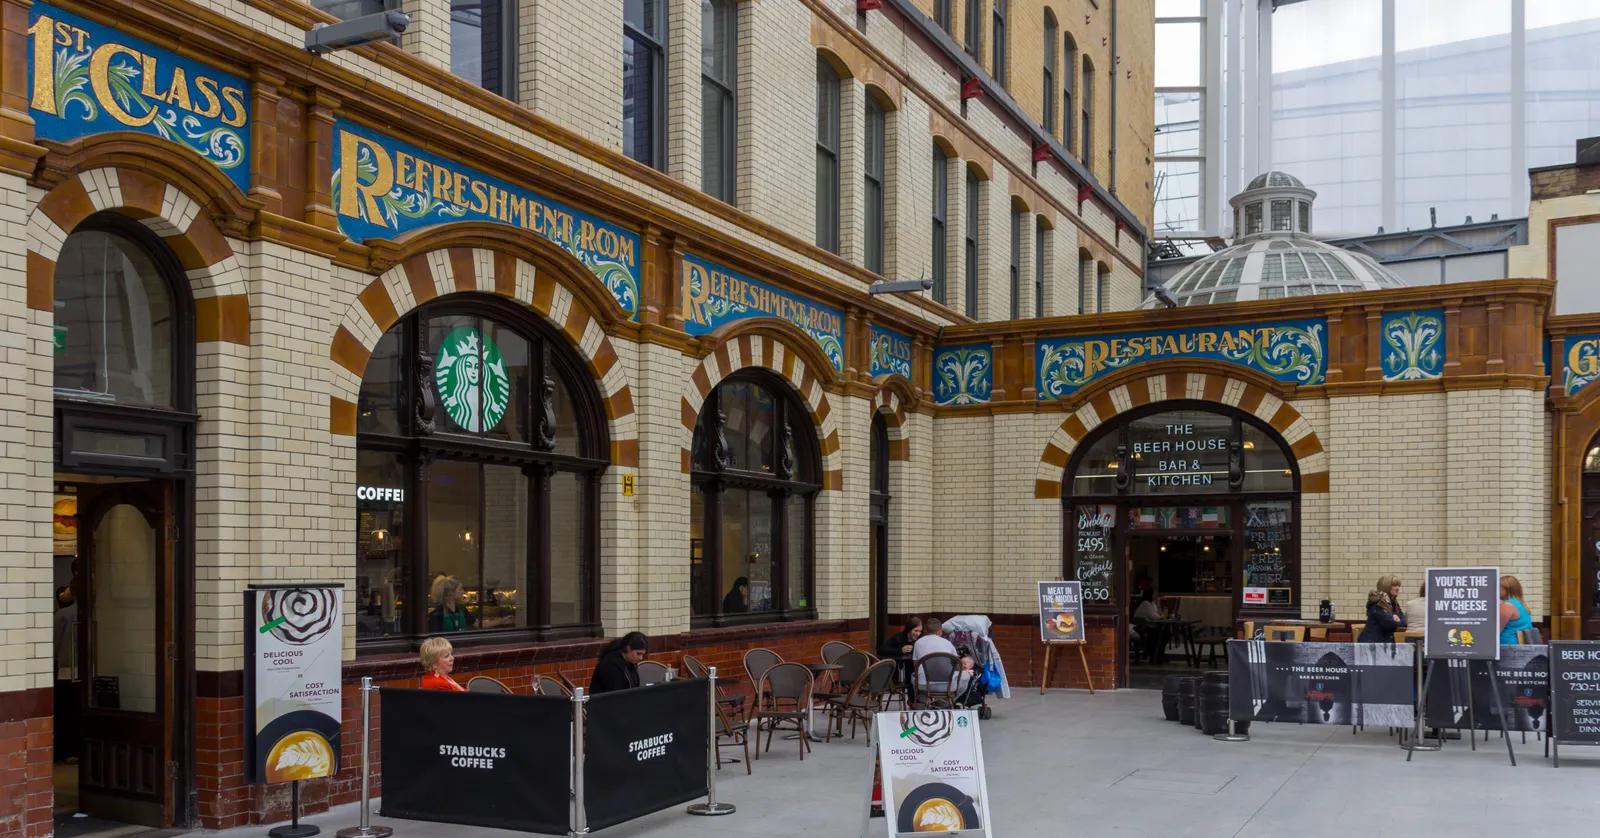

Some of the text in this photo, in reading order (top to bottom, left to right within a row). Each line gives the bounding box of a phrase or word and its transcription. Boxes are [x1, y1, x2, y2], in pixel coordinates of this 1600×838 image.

[88, 43, 248, 128] CLASS
[338, 129, 635, 267] REFRESHMENT ROOM
[681, 259, 841, 338] REFRESHMENT ROOM
[878, 334, 911, 369] CLASS
[1083, 327, 1276, 379] RESTAURANT
[1568, 339, 1600, 376] G
[1165, 424, 1193, 435] THE
[1133, 439, 1227, 453] BEER HOUSE
[1158, 459, 1201, 472] BAR &
[1147, 474, 1213, 486] KITCHEN
[1078, 513, 1112, 529] Bubbly
[1077, 560, 1113, 581] Cocktails
[1435, 576, 1488, 587] YOU'RE THE
[1047, 587, 1072, 595] MEAT IN
[1444, 588, 1479, 599] MAC TO
[1042, 595, 1078, 603] THE MIDDLE
[1435, 600, 1488, 611] MY CHEESE
[263, 650, 303, 659] DELICIOUS
[1562, 650, 1585, 660] BEER
[1562, 672, 1591, 681] OPEN
[289, 688, 339, 698] SATISFACTION
[629, 732, 673, 752] STARBUCKS
[439, 744, 506, 758] STARBUCKS
[637, 745, 666, 761] COFFEE
[451, 757, 494, 769] COFFEE
